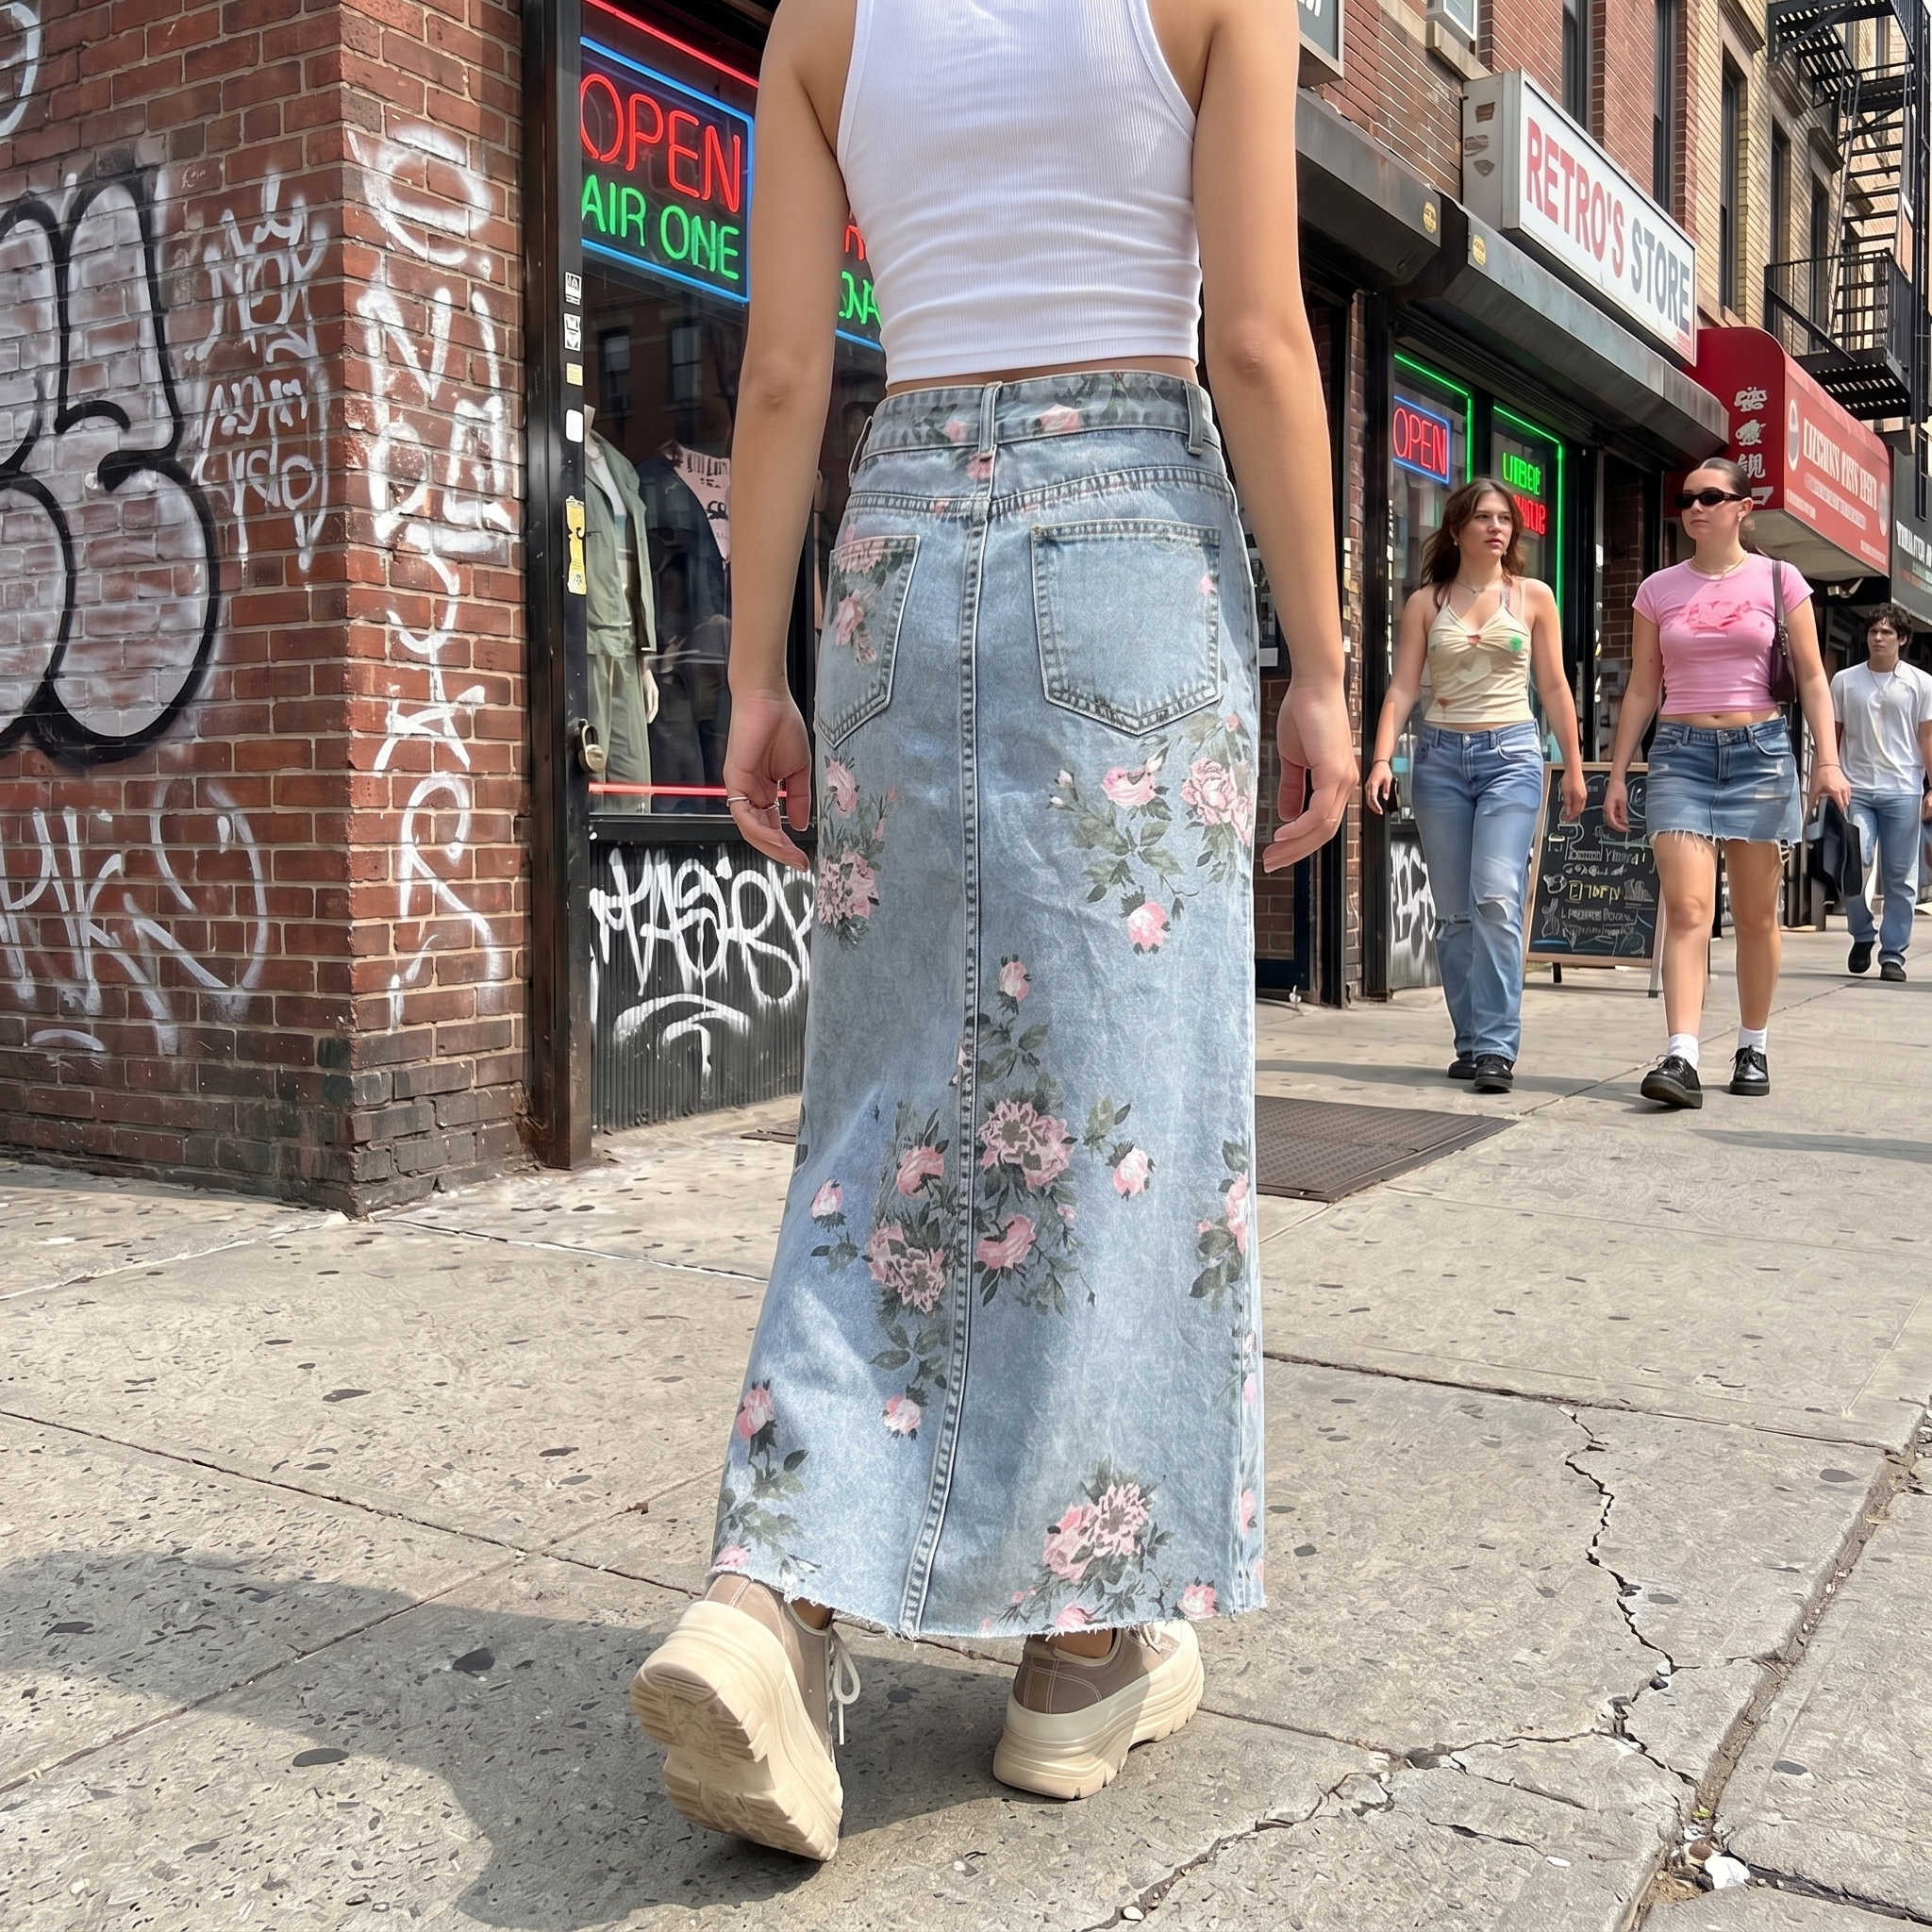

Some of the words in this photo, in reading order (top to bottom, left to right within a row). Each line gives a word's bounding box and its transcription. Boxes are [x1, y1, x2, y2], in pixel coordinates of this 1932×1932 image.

[580, 73, 741, 213] OPEN
[581, 174, 646, 247] AIR
[660, 205, 740, 280] ONE
[1526, 116, 1624, 279] RETRO'S
[1631, 218, 1690, 336] STORE
[1392, 407, 1446, 475] OPEN
